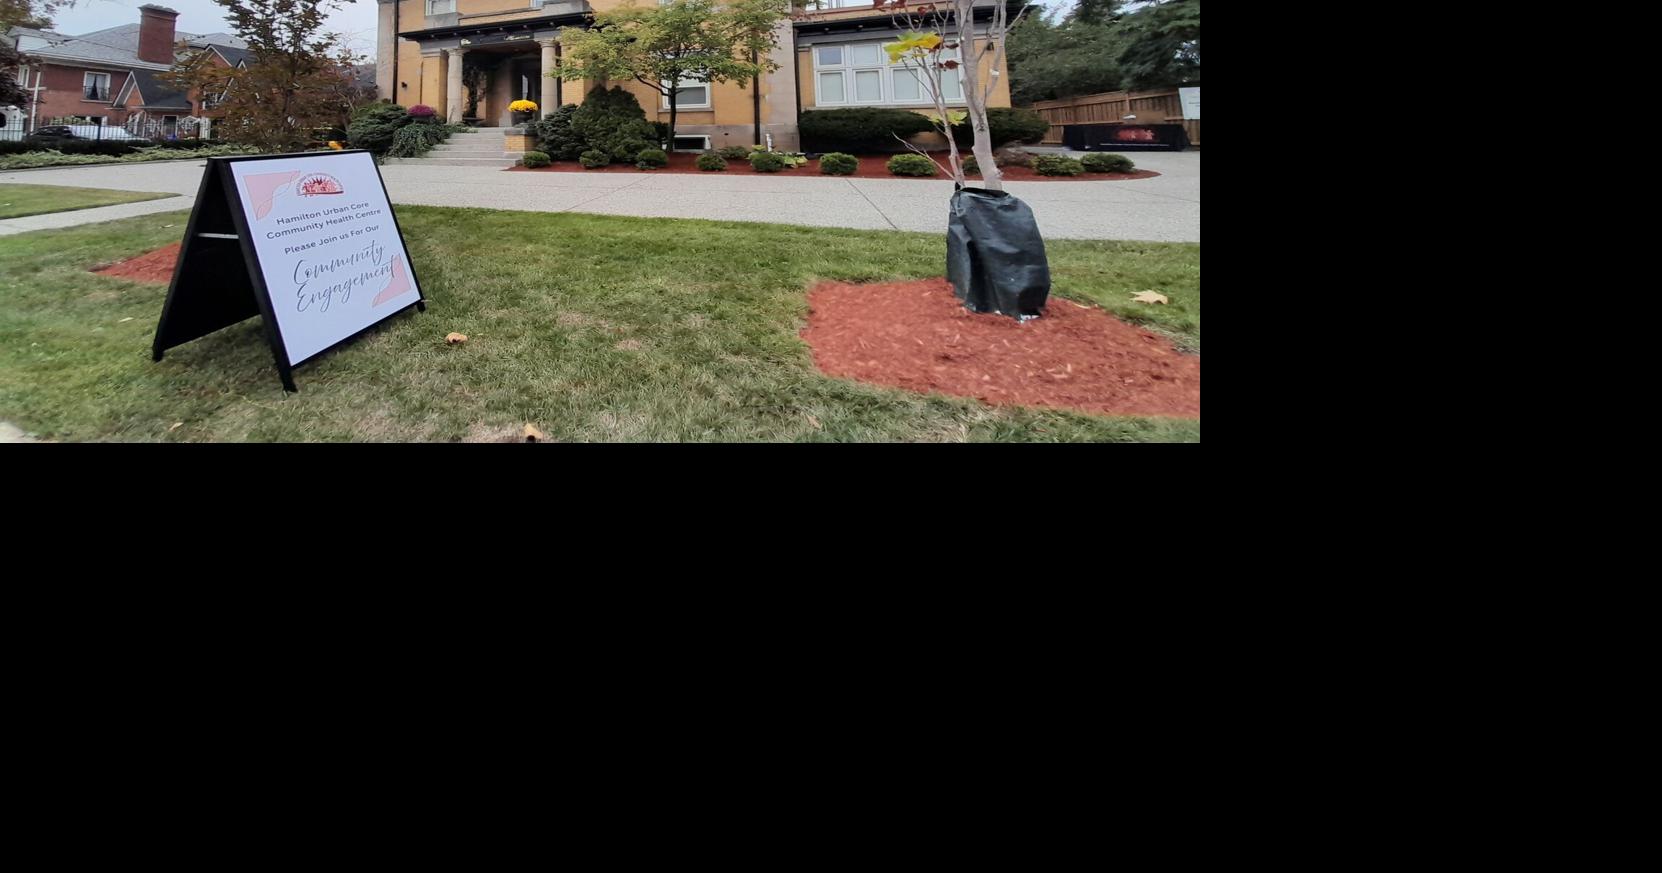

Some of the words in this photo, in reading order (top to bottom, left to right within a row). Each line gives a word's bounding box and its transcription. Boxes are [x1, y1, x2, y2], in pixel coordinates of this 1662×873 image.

[266, 221, 324, 240] Community
[325, 213, 354, 226] Health
[355, 208, 382, 219] Centre
[276, 211, 321, 225] Hamilton
[322, 205, 350, 216] Urban
[350, 202, 369, 210] Core
[284, 242, 316, 255] Please
[318, 235, 338, 246] Join
[350, 229, 364, 237] For
[365, 225, 379, 233] Our
[293, 240, 383, 284] Community
[296, 254, 395, 313] Engagement
